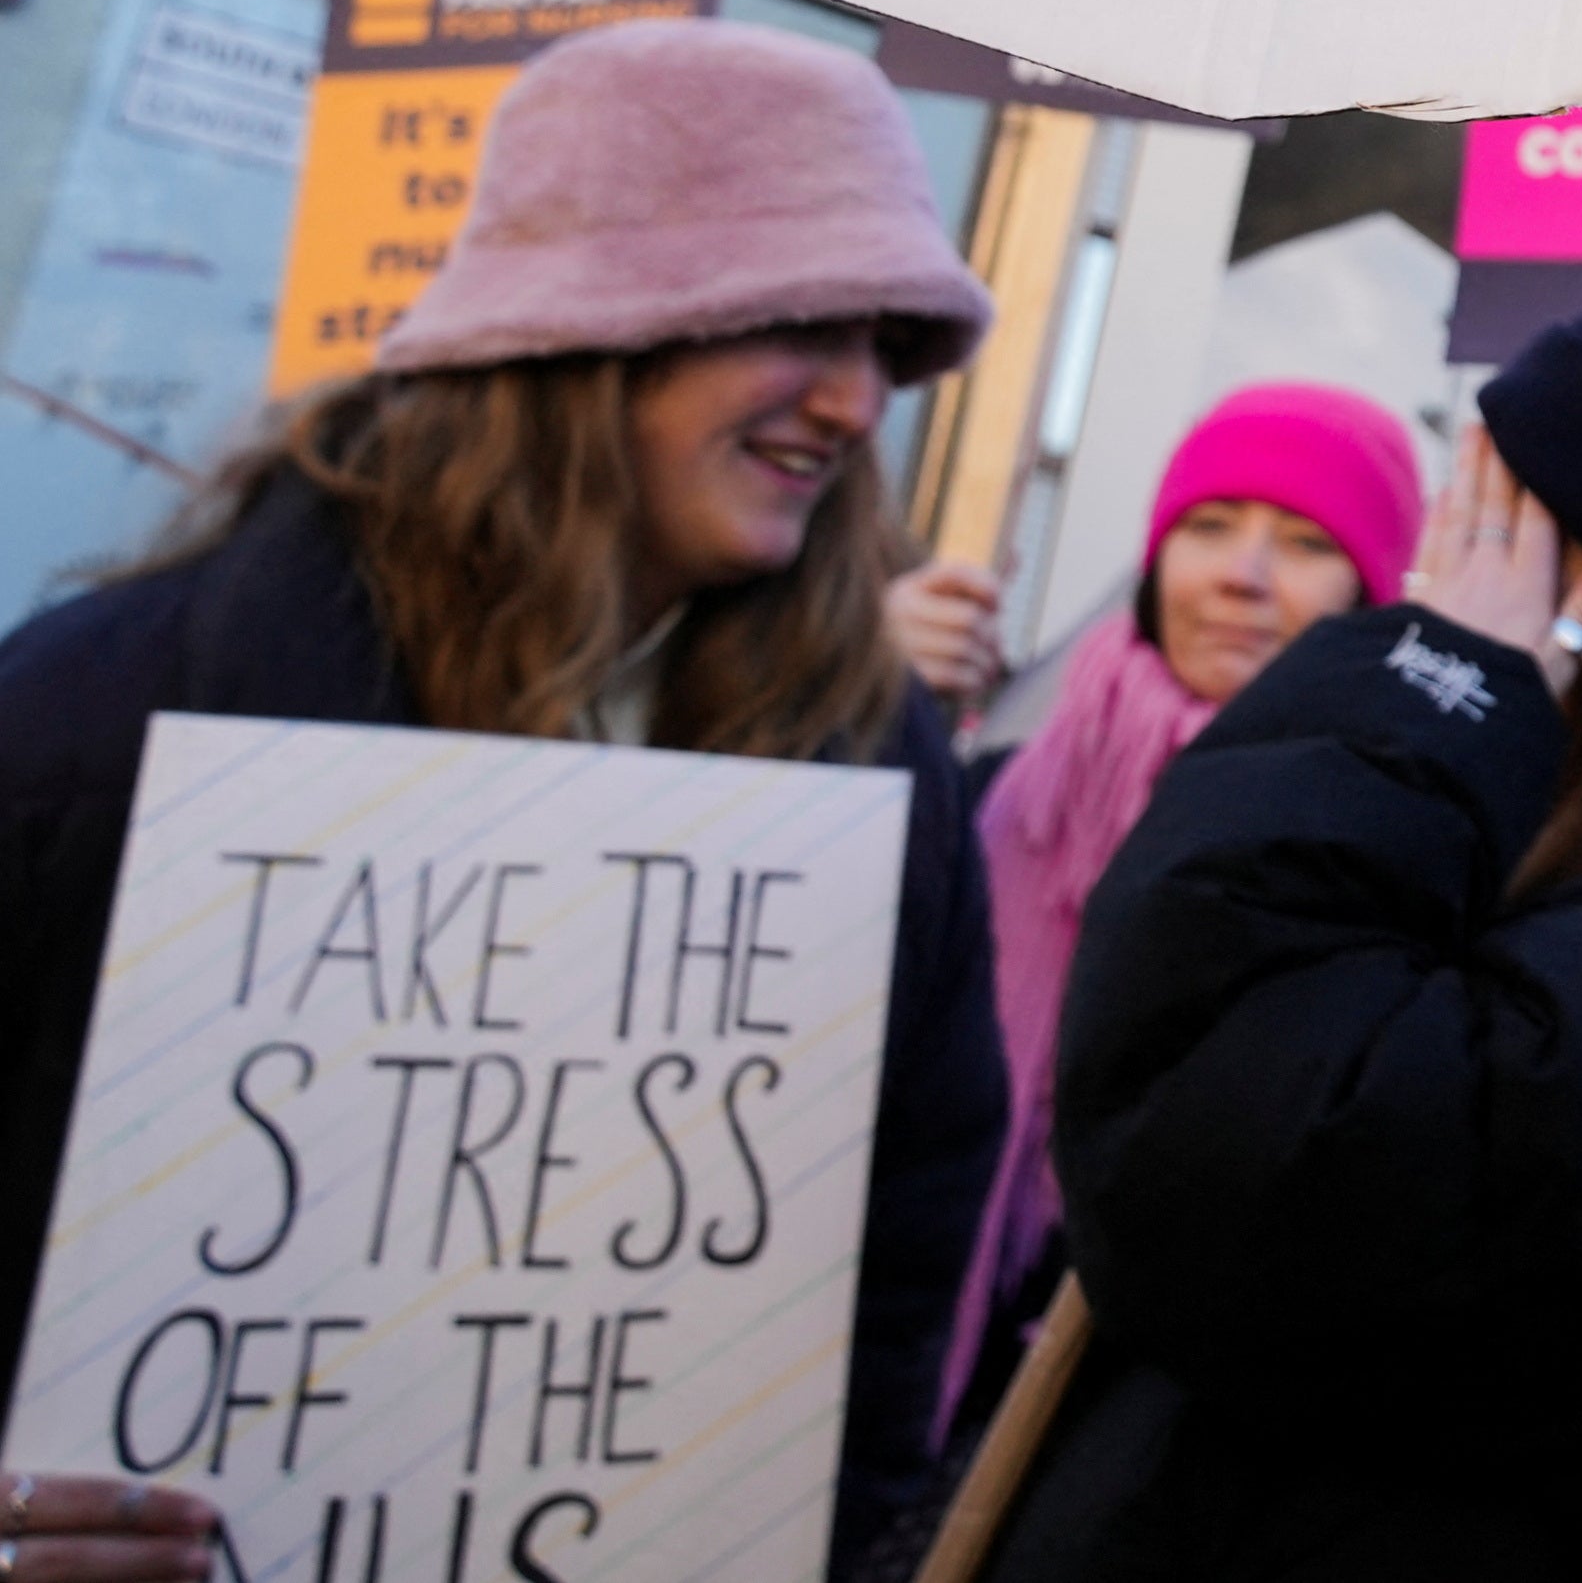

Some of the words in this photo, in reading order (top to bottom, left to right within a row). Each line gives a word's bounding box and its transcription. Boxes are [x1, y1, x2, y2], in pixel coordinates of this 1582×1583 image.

[405, 172, 468, 207] to
[222, 852, 543, 1030] TAKE
[603, 852, 803, 1039] THE
[197, 1043, 782, 1278] STRESS
[112, 1308, 367, 1476] OFF
[453, 1309, 670, 1475] THE
